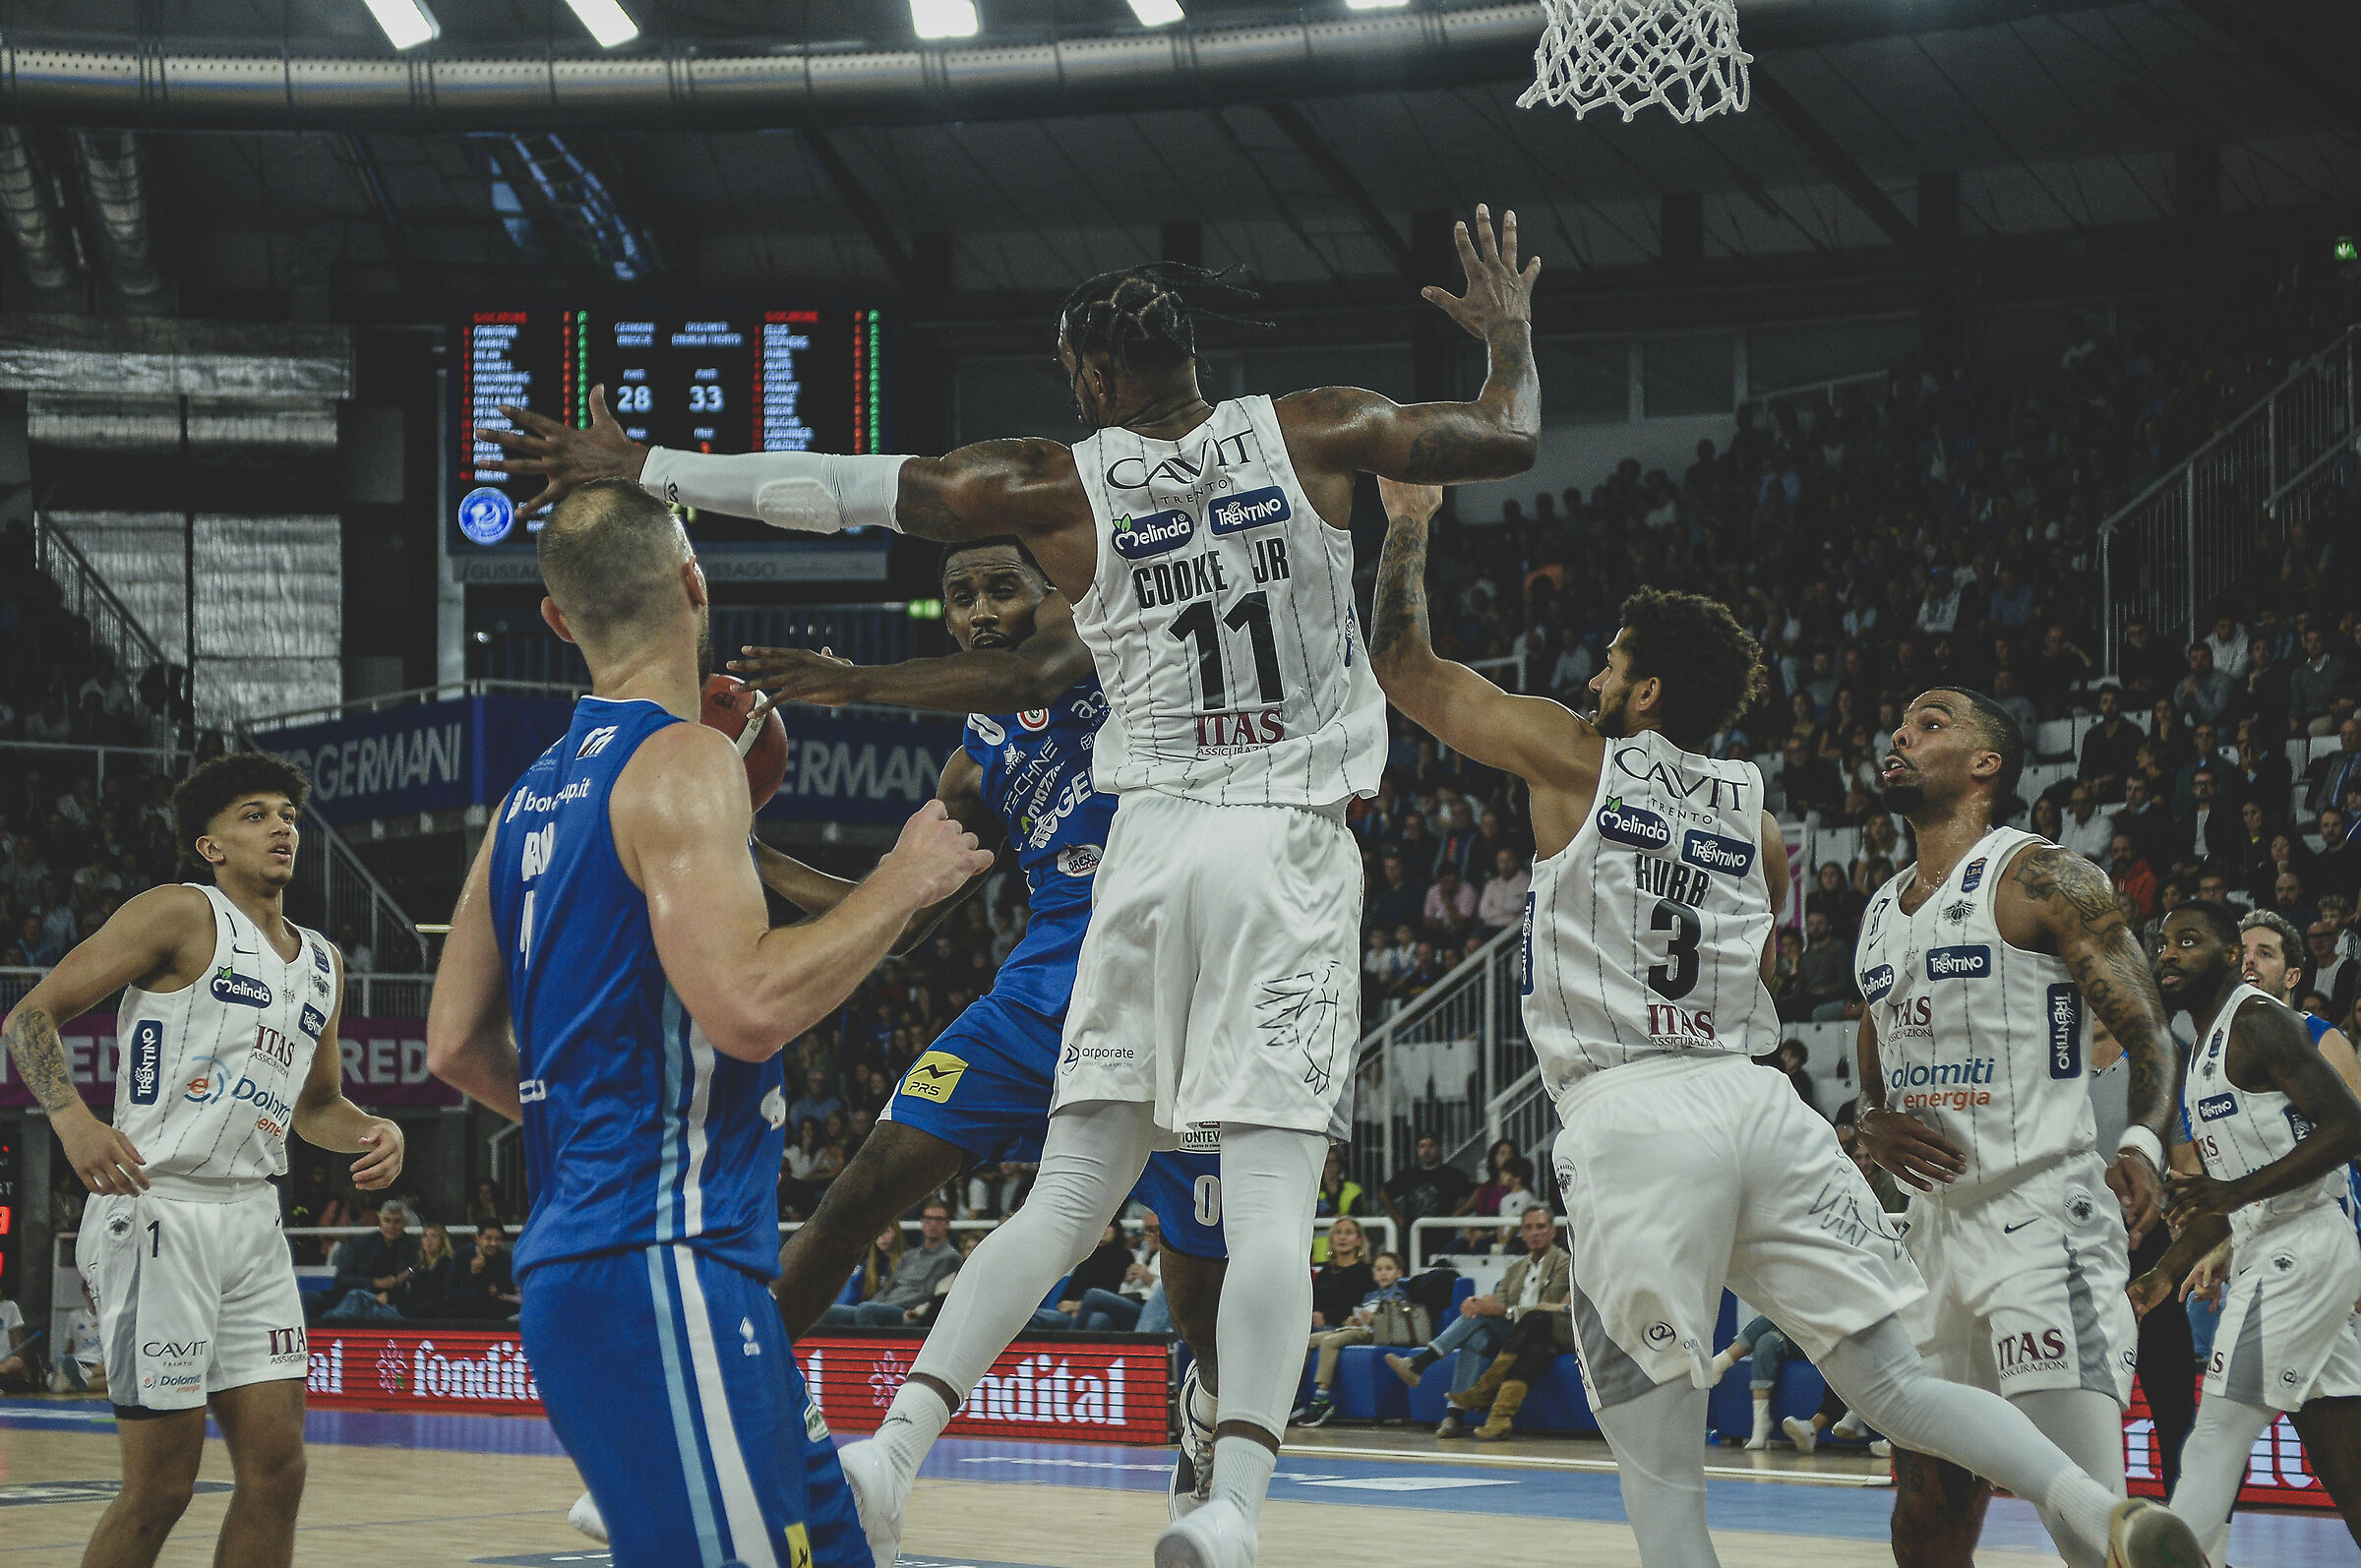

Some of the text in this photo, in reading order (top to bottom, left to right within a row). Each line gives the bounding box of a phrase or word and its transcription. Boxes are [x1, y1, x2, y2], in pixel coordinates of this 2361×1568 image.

[617, 386, 652, 412] 28
[689, 386, 724, 412] 33
[1107, 429, 1254, 489] CAVIT
[1161, 478, 1229, 506] TRENTO
[1215, 498, 1282, 526] TRENTINO
[1116, 516, 1191, 548] Melinda
[1133, 537, 1291, 609] COOKE JR
[1169, 590, 1285, 711] 11
[1196, 709, 1286, 746] ITAS
[314, 722, 461, 801] GERMANI
[1613, 747, 1748, 812] CAVIT
[1600, 812, 1667, 841] Melinda
[1652, 798, 1713, 824] TRENTO
[1691, 839, 1747, 868] TRENTINO
[1648, 898, 1702, 1002] 3
[1931, 955, 1983, 974] TRENTINO
[213, 978, 270, 1002] Melinda
[1864, 970, 1893, 996] elinda
[1648, 1003, 1715, 1041] ITAS
[2054, 993, 2072, 1070] TRENTINO
[136, 1027, 153, 1097] TRENTINO
[255, 1025, 295, 1067] ITAS
[1891, 1056, 1995, 1089] olomiti
[909, 1081, 941, 1097] PRS
[1904, 1087, 1991, 1112] energia
[147, 1220, 159, 1258] 1
[143, 1341, 208, 1357] CAVIT
[268, 1326, 307, 1356] ITA
[1998, 1329, 2067, 1370] ITAS
